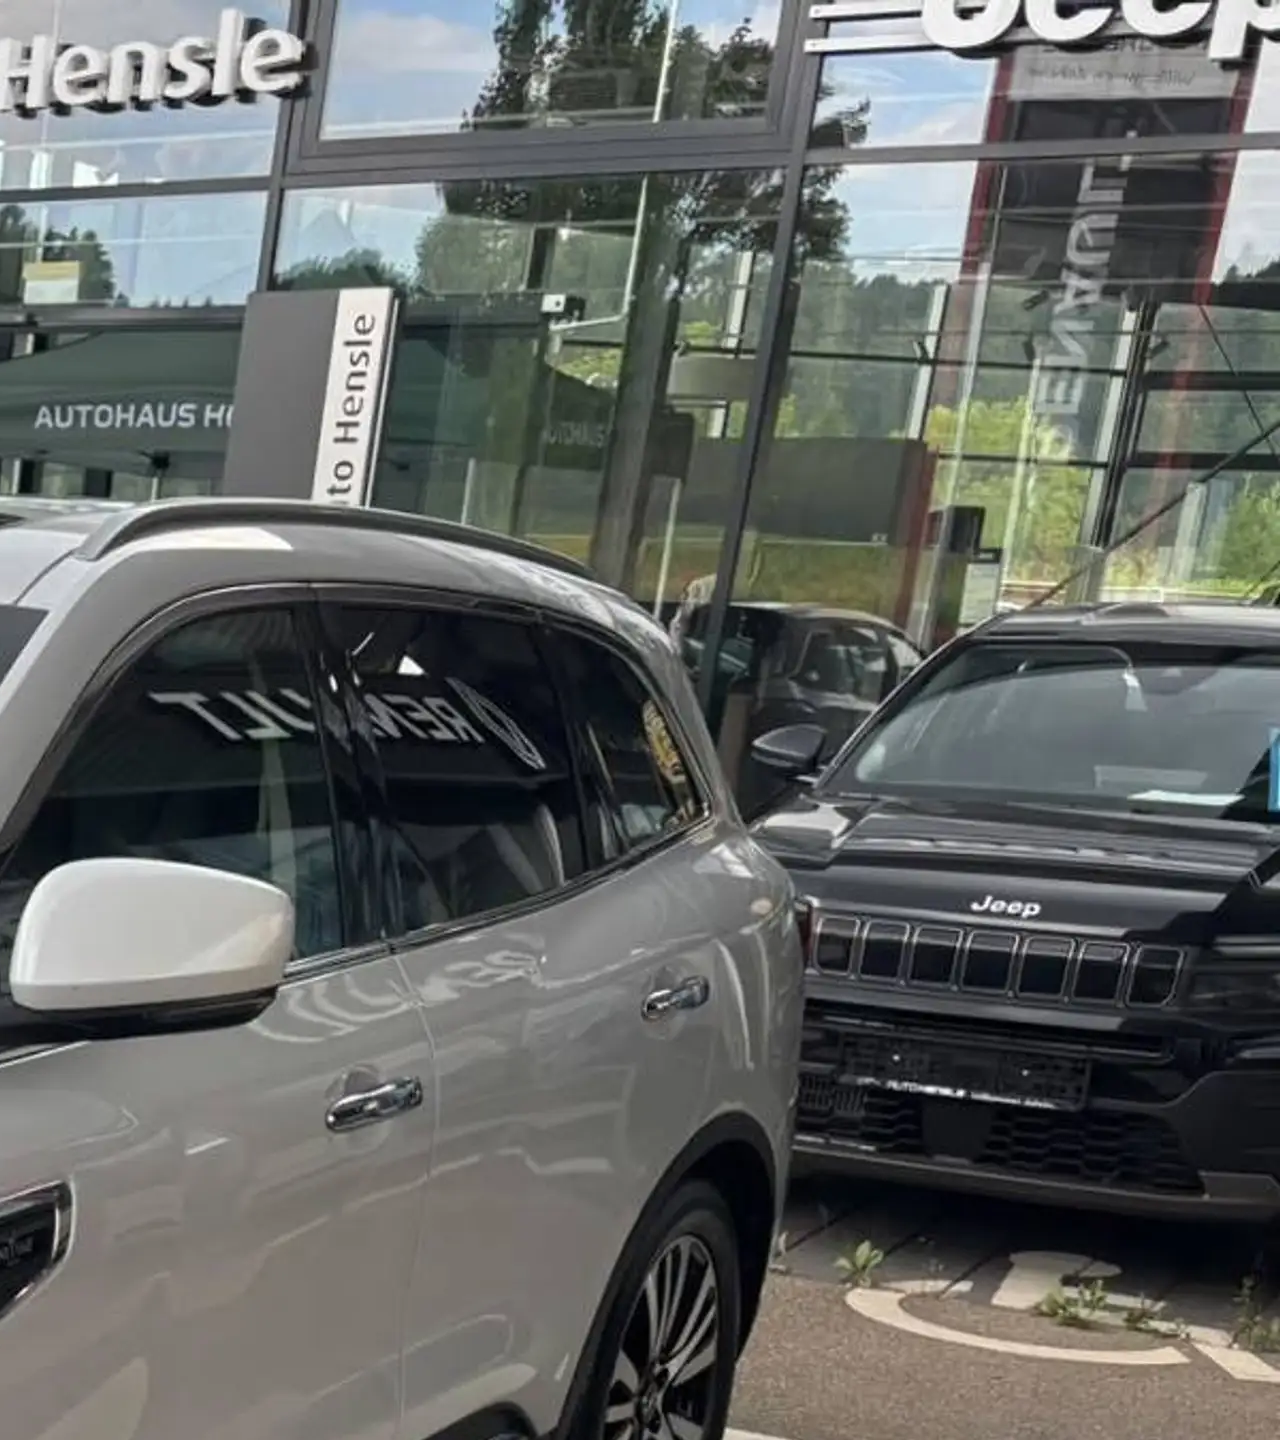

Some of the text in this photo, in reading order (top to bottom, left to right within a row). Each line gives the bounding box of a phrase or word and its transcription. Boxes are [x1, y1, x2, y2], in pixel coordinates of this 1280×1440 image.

[333, 313, 375, 444] Hensle
[34, 403, 197, 430] AUTOHAUS
[971, 895, 1041, 918] Jeep
